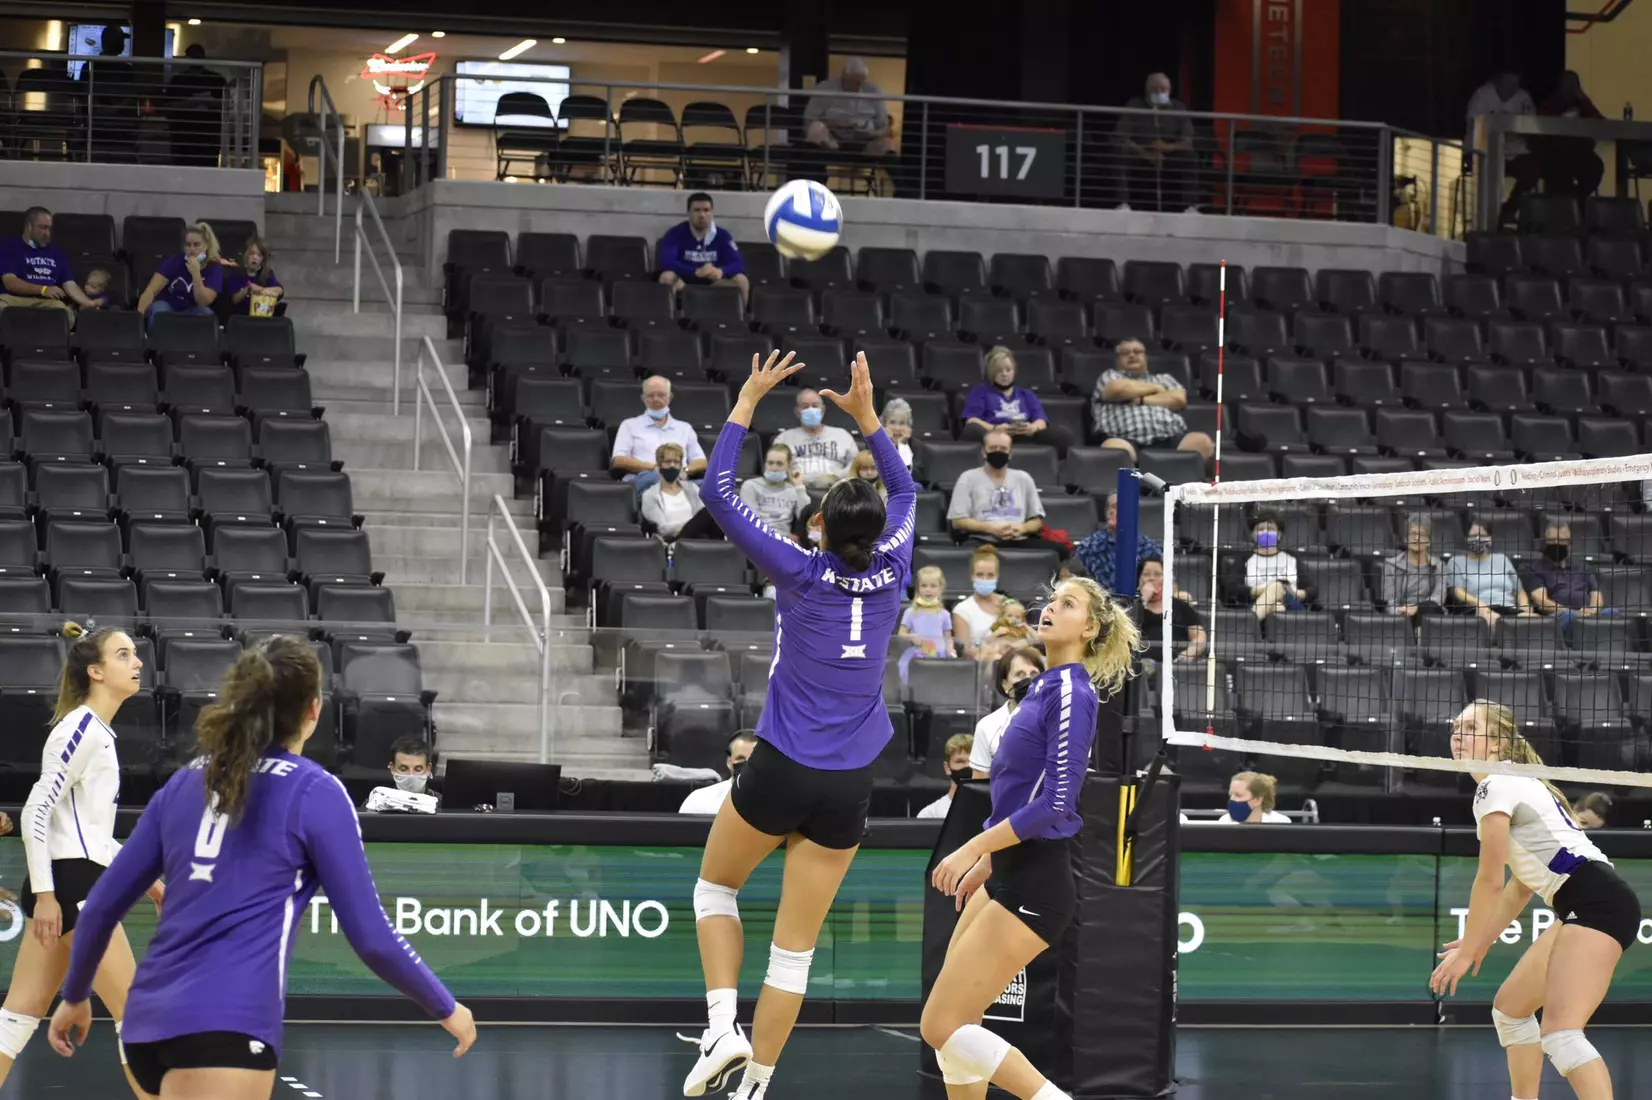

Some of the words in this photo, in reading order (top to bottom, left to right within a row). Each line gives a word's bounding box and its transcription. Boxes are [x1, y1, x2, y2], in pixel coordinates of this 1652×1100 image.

[976, 144, 1037, 180] 117
[821, 567, 896, 593] K-STATE
[850, 597, 863, 641] 1
[396, 897, 503, 936] Bank
[515, 899, 559, 936] of
[570, 898, 669, 938] UNO
[994, 994, 1023, 1006] ASING
[1004, 982, 1024, 994] ORS
